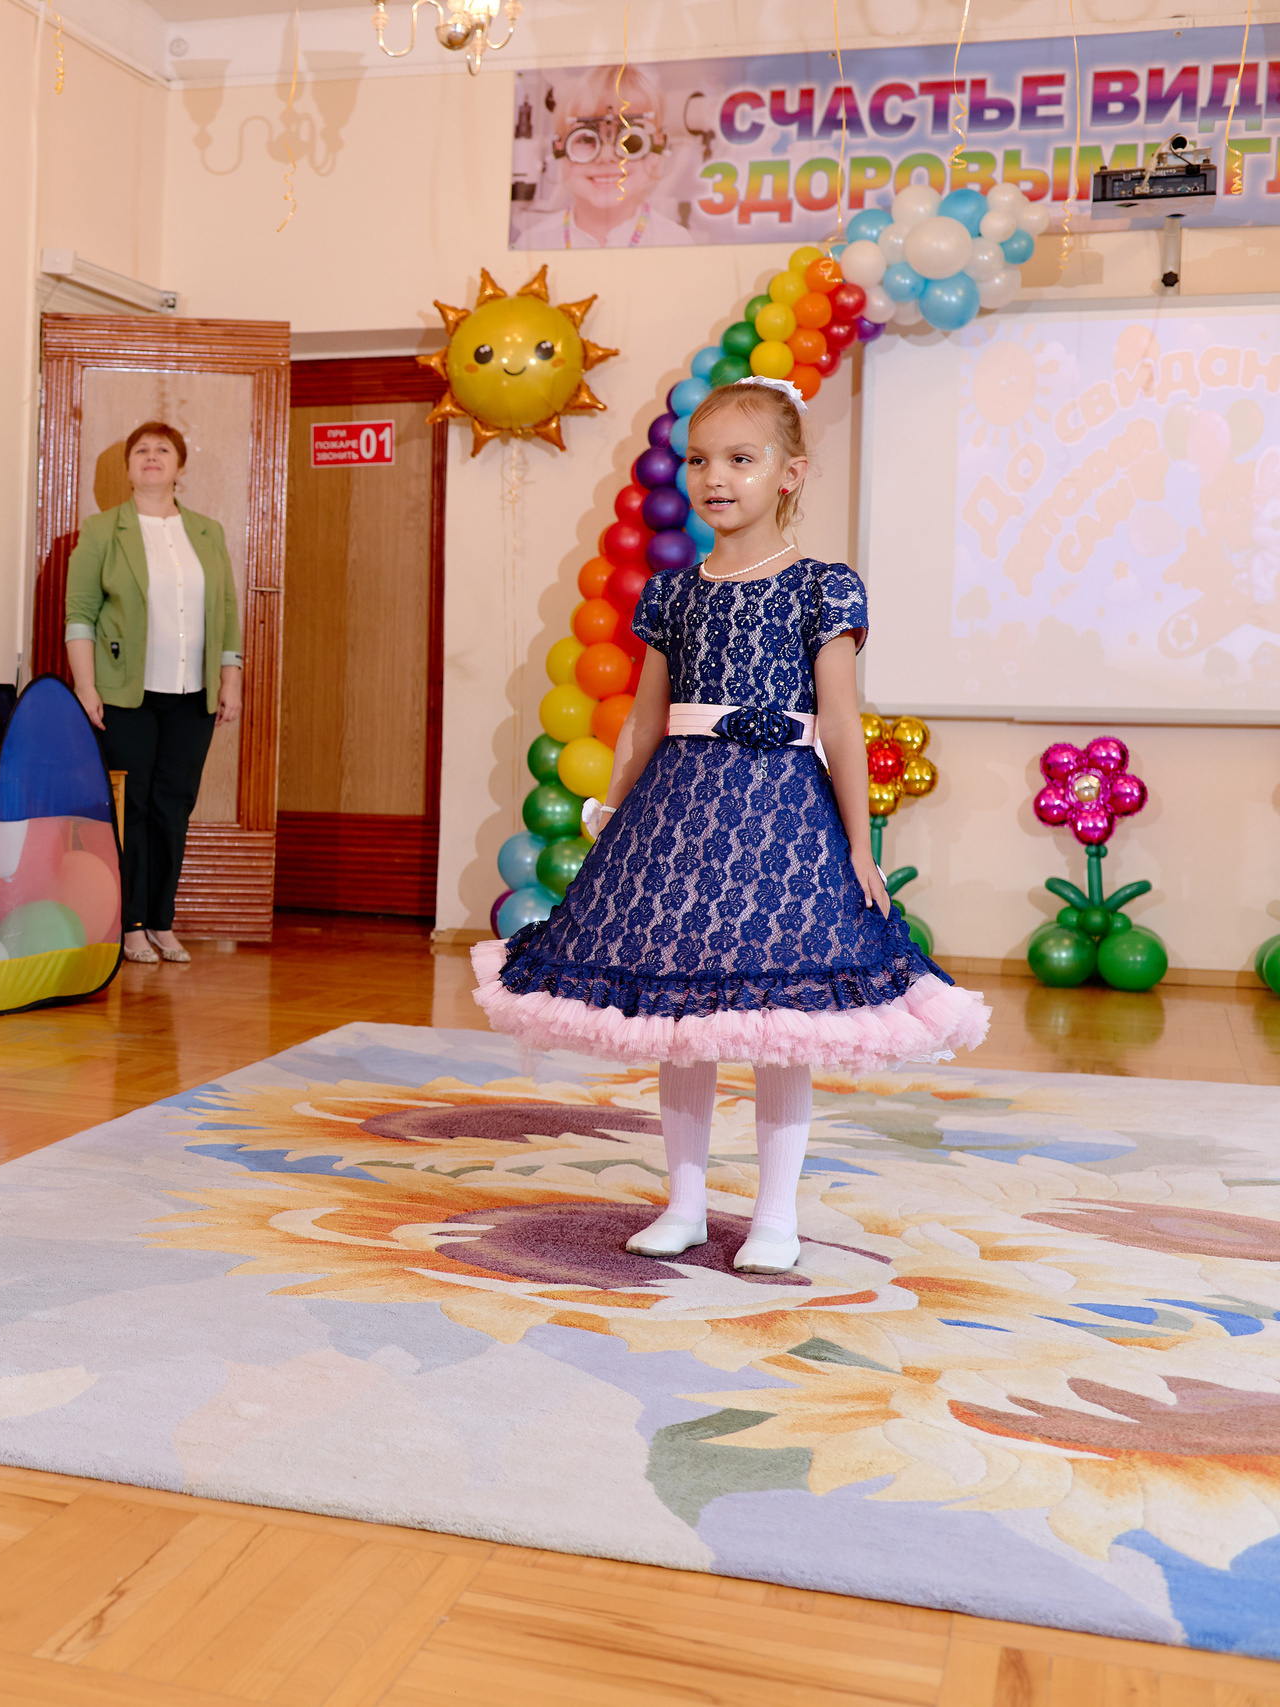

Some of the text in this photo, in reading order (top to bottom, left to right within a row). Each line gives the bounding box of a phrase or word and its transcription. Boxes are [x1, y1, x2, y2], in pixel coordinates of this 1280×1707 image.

[719, 73, 1066, 145] СЧАСТЬЕ
[327, 429, 347, 438] ПРИ
[315, 439, 359, 450] ПОЖАРЕ
[360, 426, 392, 460] 01
[316, 450, 359, 461] ЗВОНИТЬ
